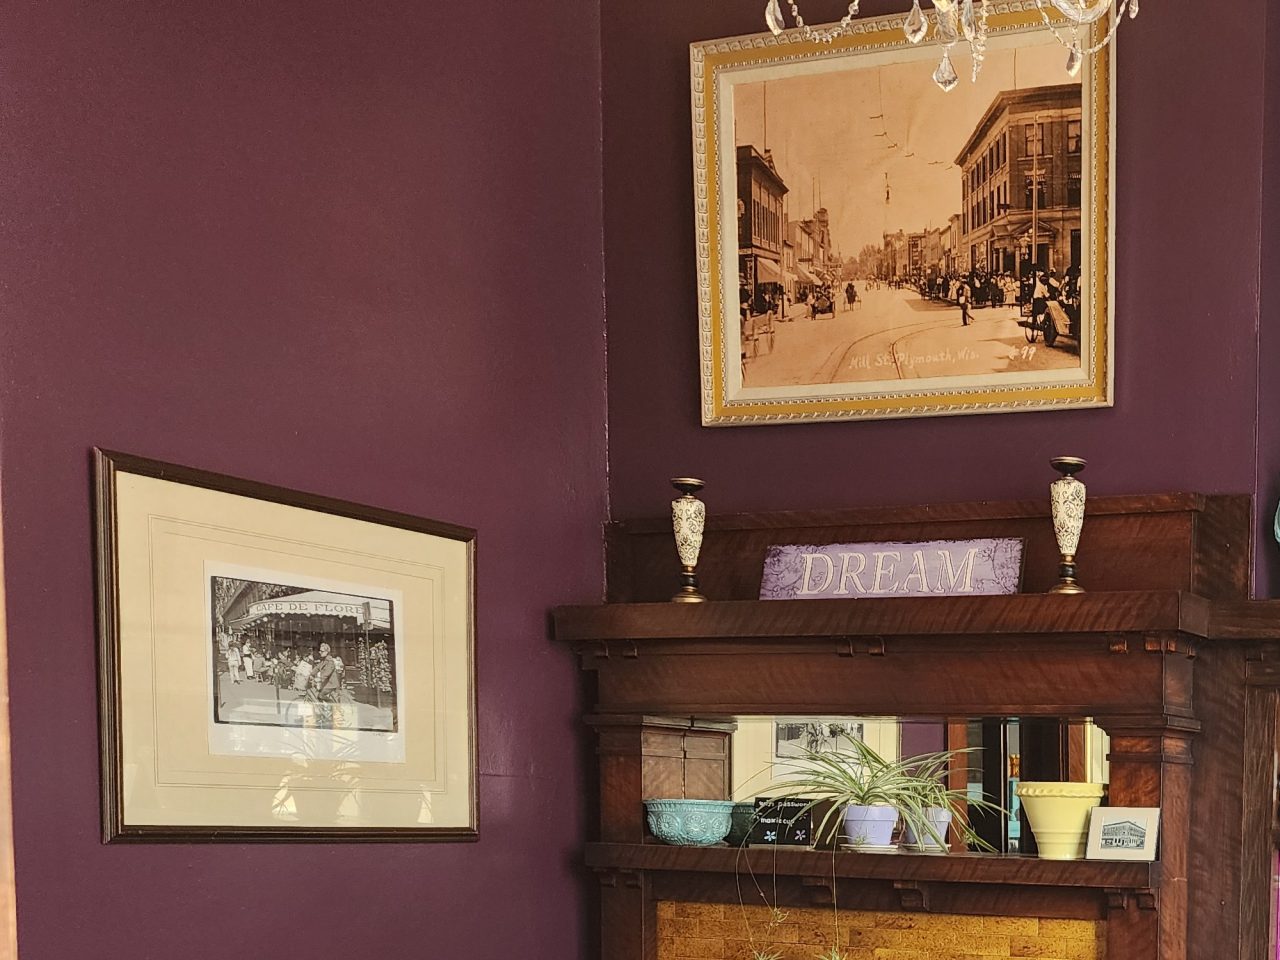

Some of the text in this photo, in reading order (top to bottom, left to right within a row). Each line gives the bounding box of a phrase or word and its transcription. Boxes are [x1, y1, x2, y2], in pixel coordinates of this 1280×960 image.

[849, 352, 871, 370] Mill
[958, 347, 980, 361] Wis.
[797, 548, 979, 595] DREAM
[255, 602, 363, 614] CAFE DE FLORE
